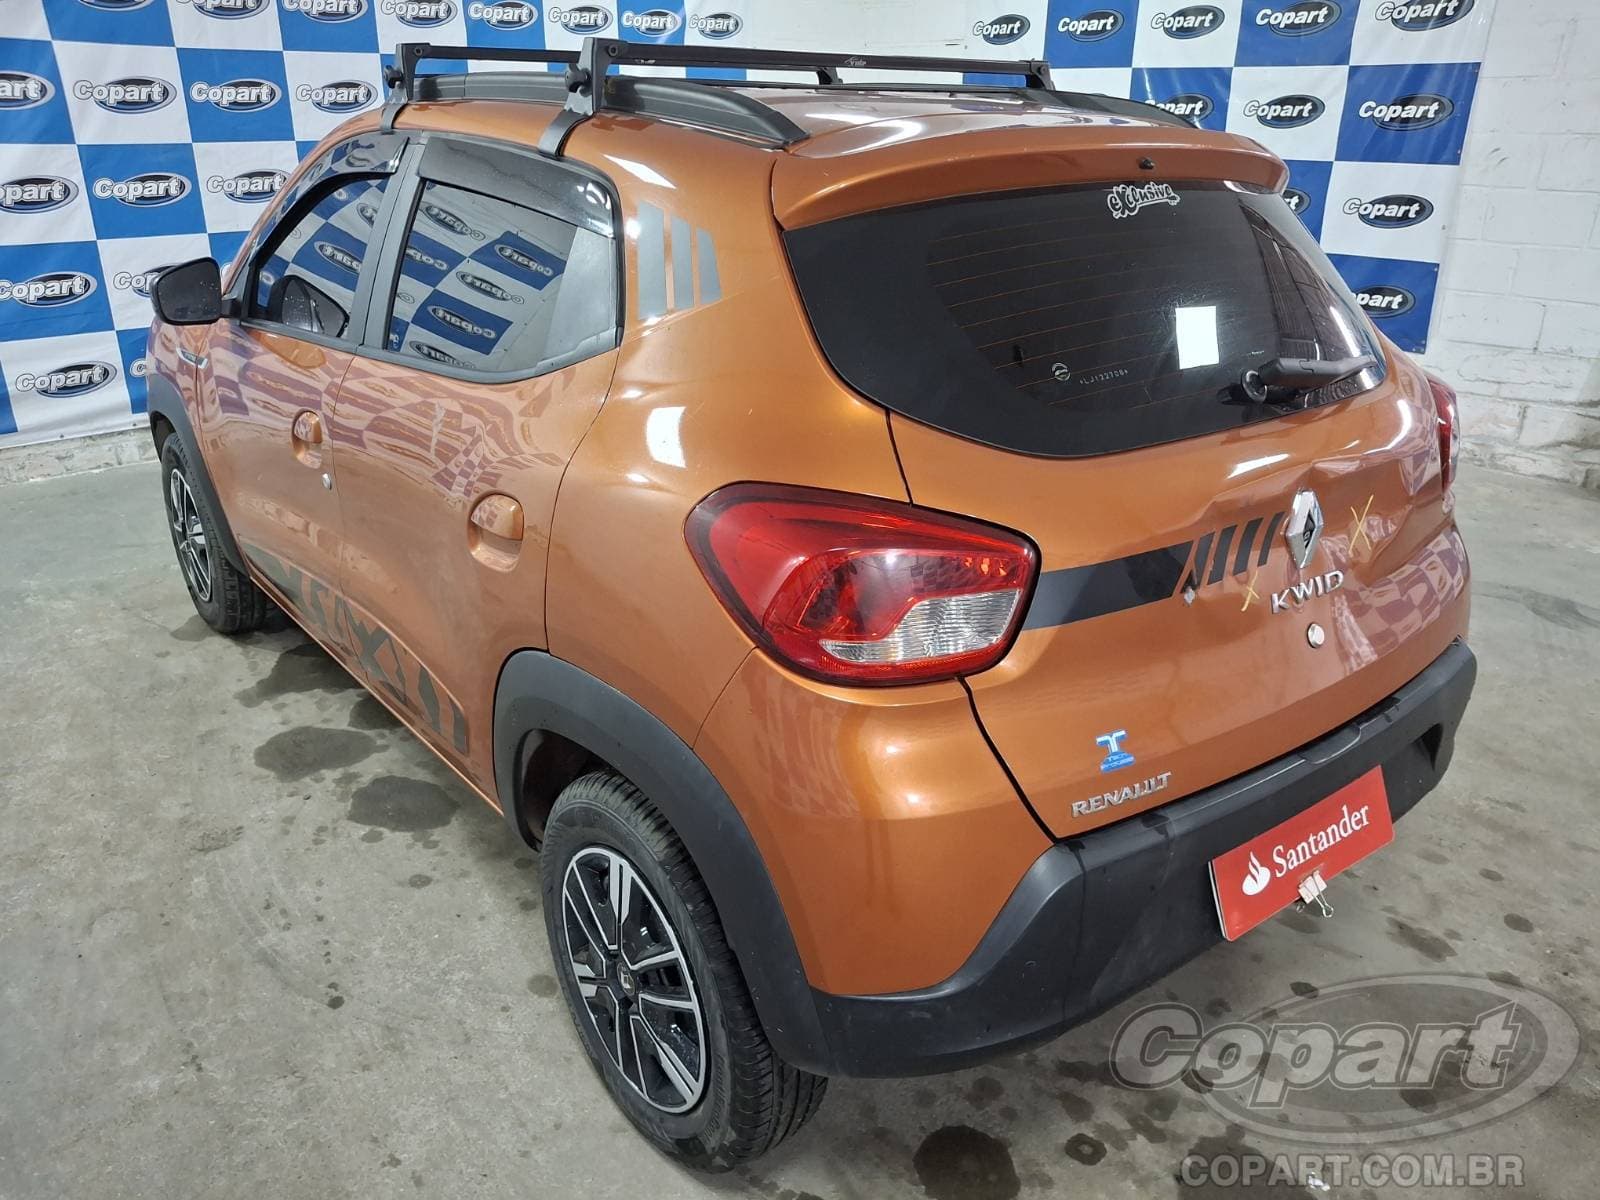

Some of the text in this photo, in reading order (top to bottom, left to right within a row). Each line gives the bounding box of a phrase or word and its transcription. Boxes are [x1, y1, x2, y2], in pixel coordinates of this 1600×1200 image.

[282, 0, 358, 16] Copart
[381, 0, 448, 20] Copart
[468, 1, 531, 23] Copart
[549, 6, 606, 27] Copart
[1256, 6, 1329, 28] Copart
[1375, 0, 1459, 23] Copart
[622, 12, 674, 33] Copart
[689, 16, 738, 35] Copart
[973, 20, 1021, 37] Copart
[1057, 16, 1115, 34] Copart
[1151, 12, 1214, 32] Copart
[73, 80, 164, 107] Copart
[190, 82, 271, 106] Copart
[296, 84, 372, 105] Copart
[1243, 100, 1314, 120] Copart
[1359, 101, 1440, 122] Copart
[0, 180, 65, 206] part
[94, 177, 180, 202] Copart
[207, 174, 283, 196] Copart
[1343, 198, 1421, 220] Copart
[0, 276, 85, 303] Copart
[1352, 292, 1403, 310] part
[16, 366, 104, 392] Copart
[1271, 570, 1344, 614] KWID
[1071, 771, 1172, 818] RENAULT
[1272, 804, 1370, 878] Santander
